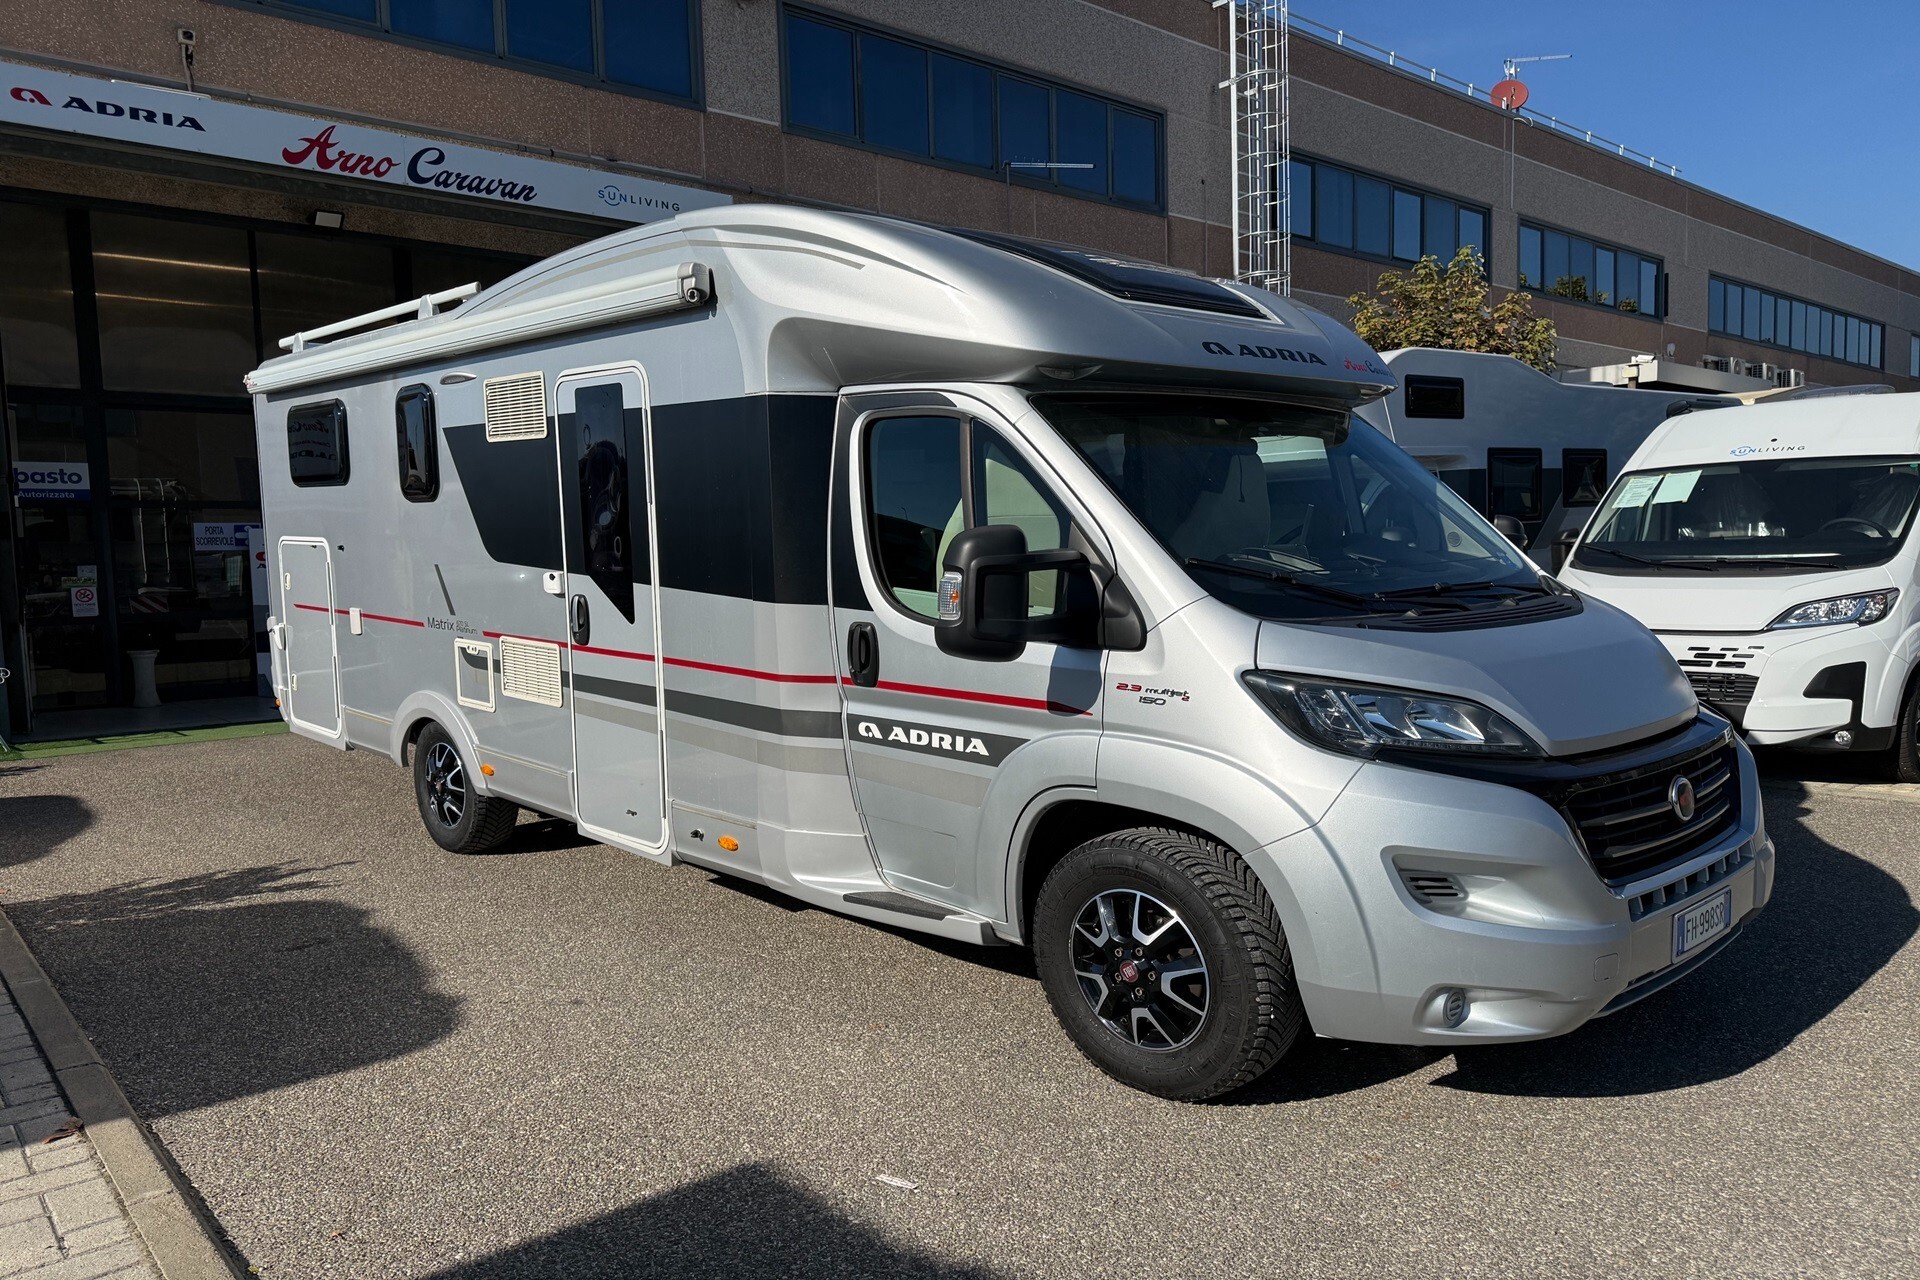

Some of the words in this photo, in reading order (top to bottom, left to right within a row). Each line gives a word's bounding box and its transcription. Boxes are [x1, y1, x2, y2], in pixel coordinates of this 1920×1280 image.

[61, 95, 206, 132] ADRIA
[282, 125, 401, 178] Arno
[407, 147, 538, 201] Caravan
[598, 185, 680, 211] SUNLIVING
[1237, 343, 1327, 366] ADRIA
[1730, 446, 1806, 456] SUNLIVING
[204, 526, 225, 535] PORTA
[195, 537, 235, 546] SCORREVOLE
[427, 617, 455, 632] Matrix
[1116, 682, 1142, 692] 2.3
[1139, 696, 1166, 705] 150
[887, 726, 990, 756] ADRIA
